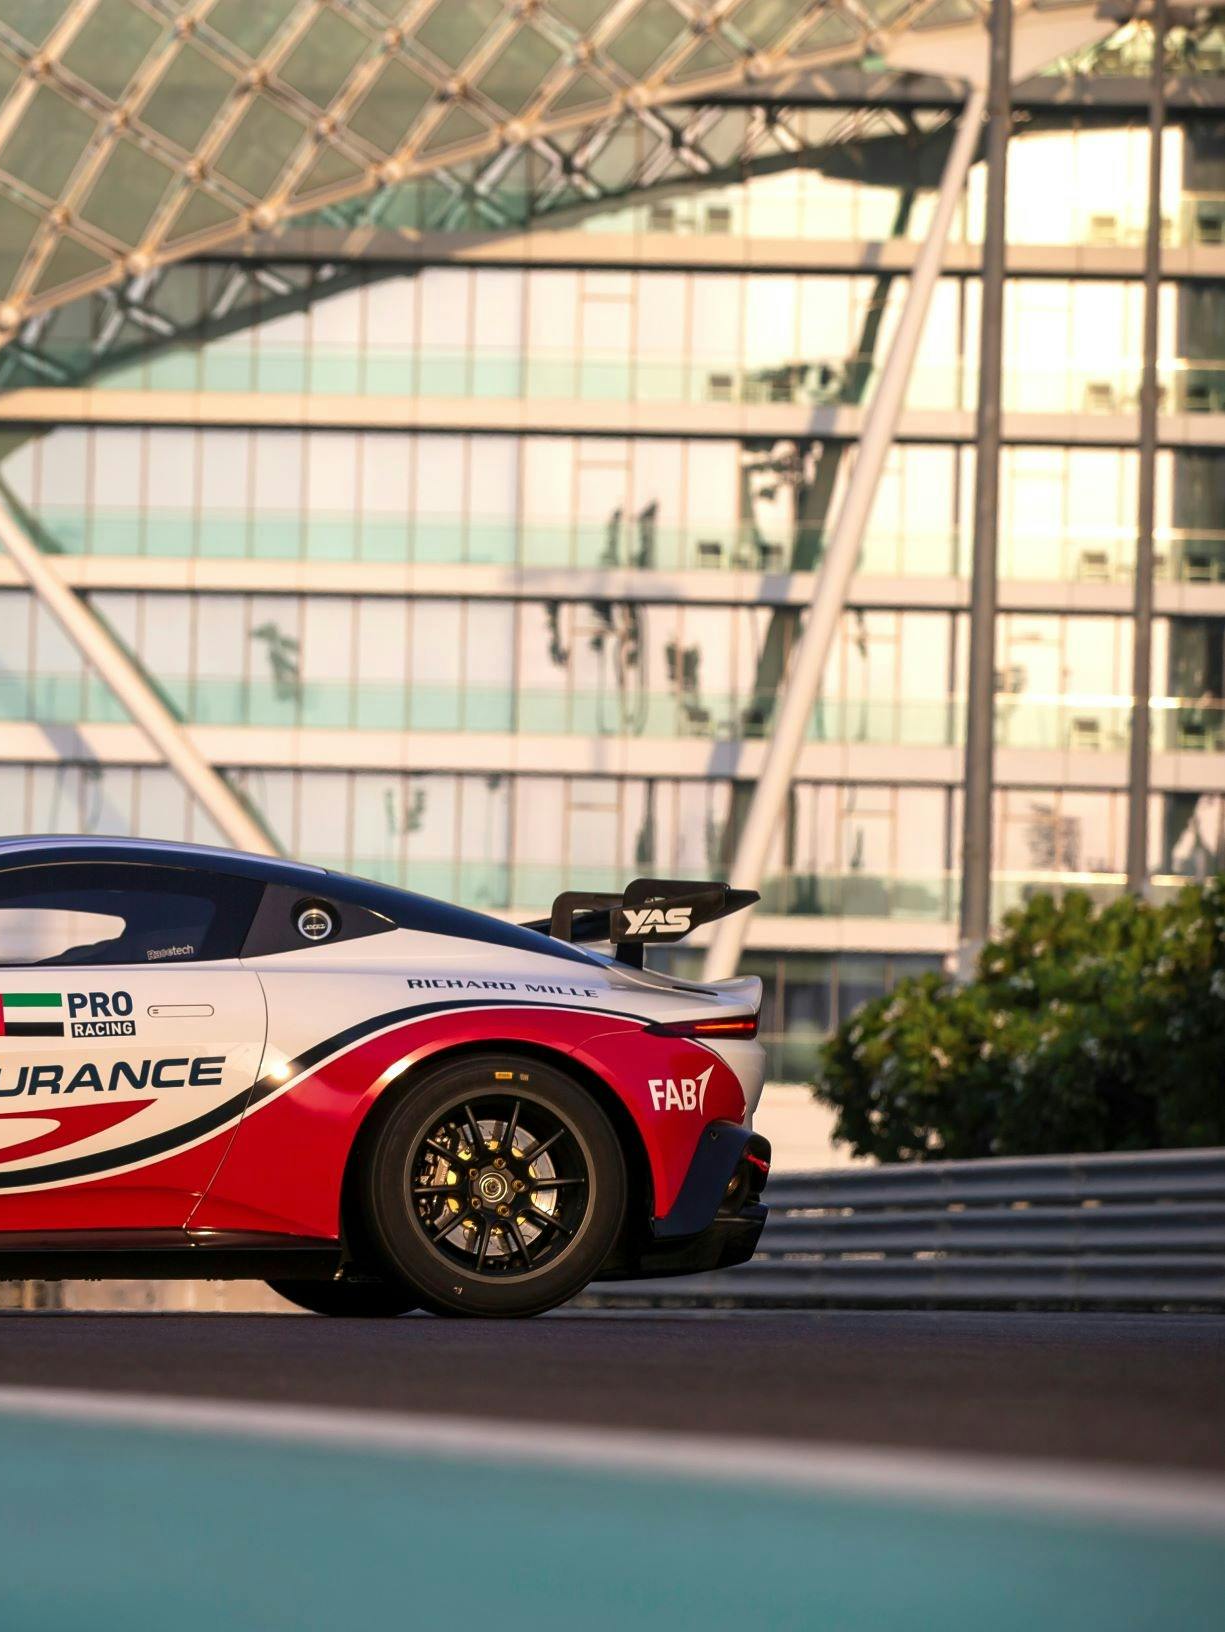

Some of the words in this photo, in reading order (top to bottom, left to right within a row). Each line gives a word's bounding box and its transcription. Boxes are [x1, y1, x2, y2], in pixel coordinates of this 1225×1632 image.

[622, 907, 693, 936] YAS
[407, 979, 516, 991] RICHARD
[525, 984, 600, 998] MILLE
[67, 991, 133, 1018] PRO
[74, 1022, 133, 1037] RACING
